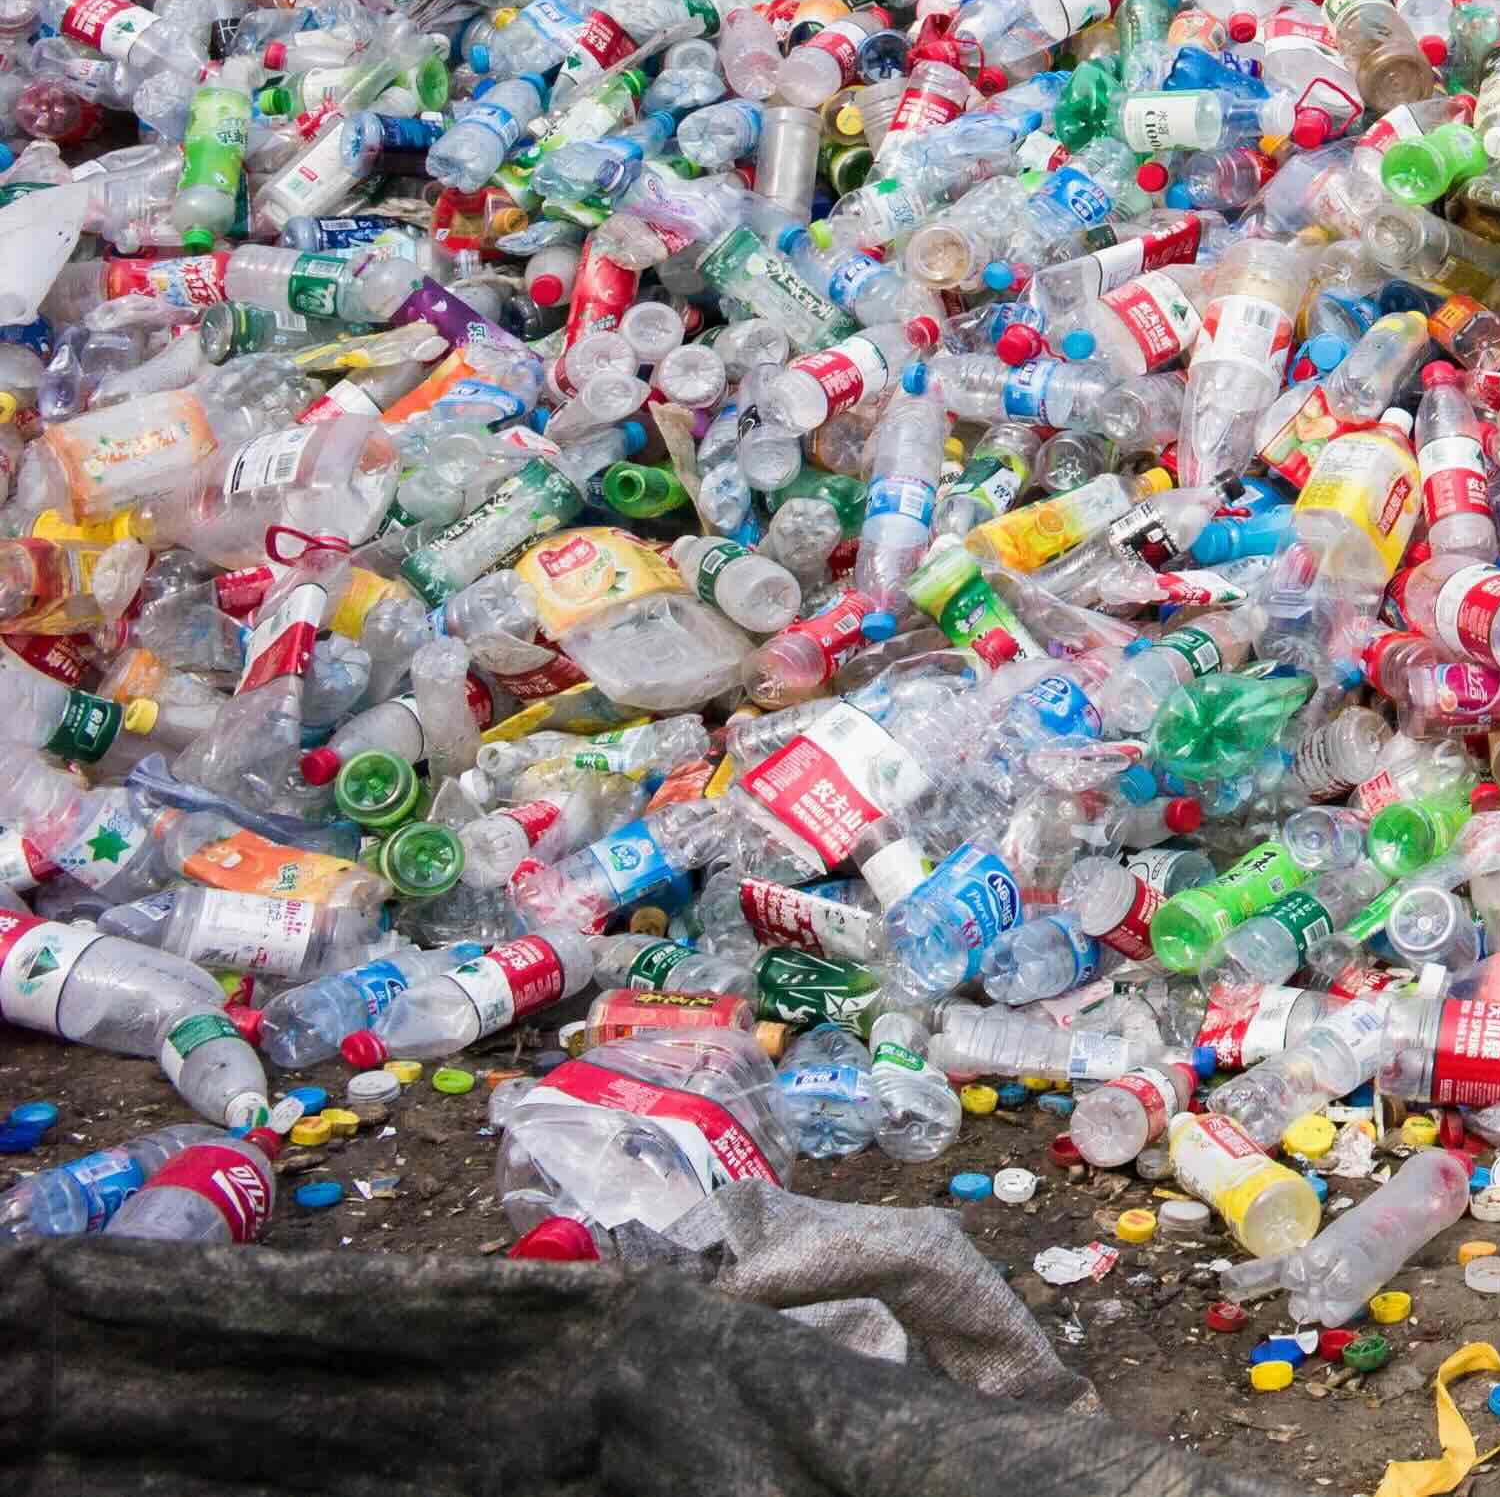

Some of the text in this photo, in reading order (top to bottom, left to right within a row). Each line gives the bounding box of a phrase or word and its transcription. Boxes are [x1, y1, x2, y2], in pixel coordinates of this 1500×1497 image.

[813, 775, 871, 832] 农夫山
[990, 876, 1015, 932] Nestlé
